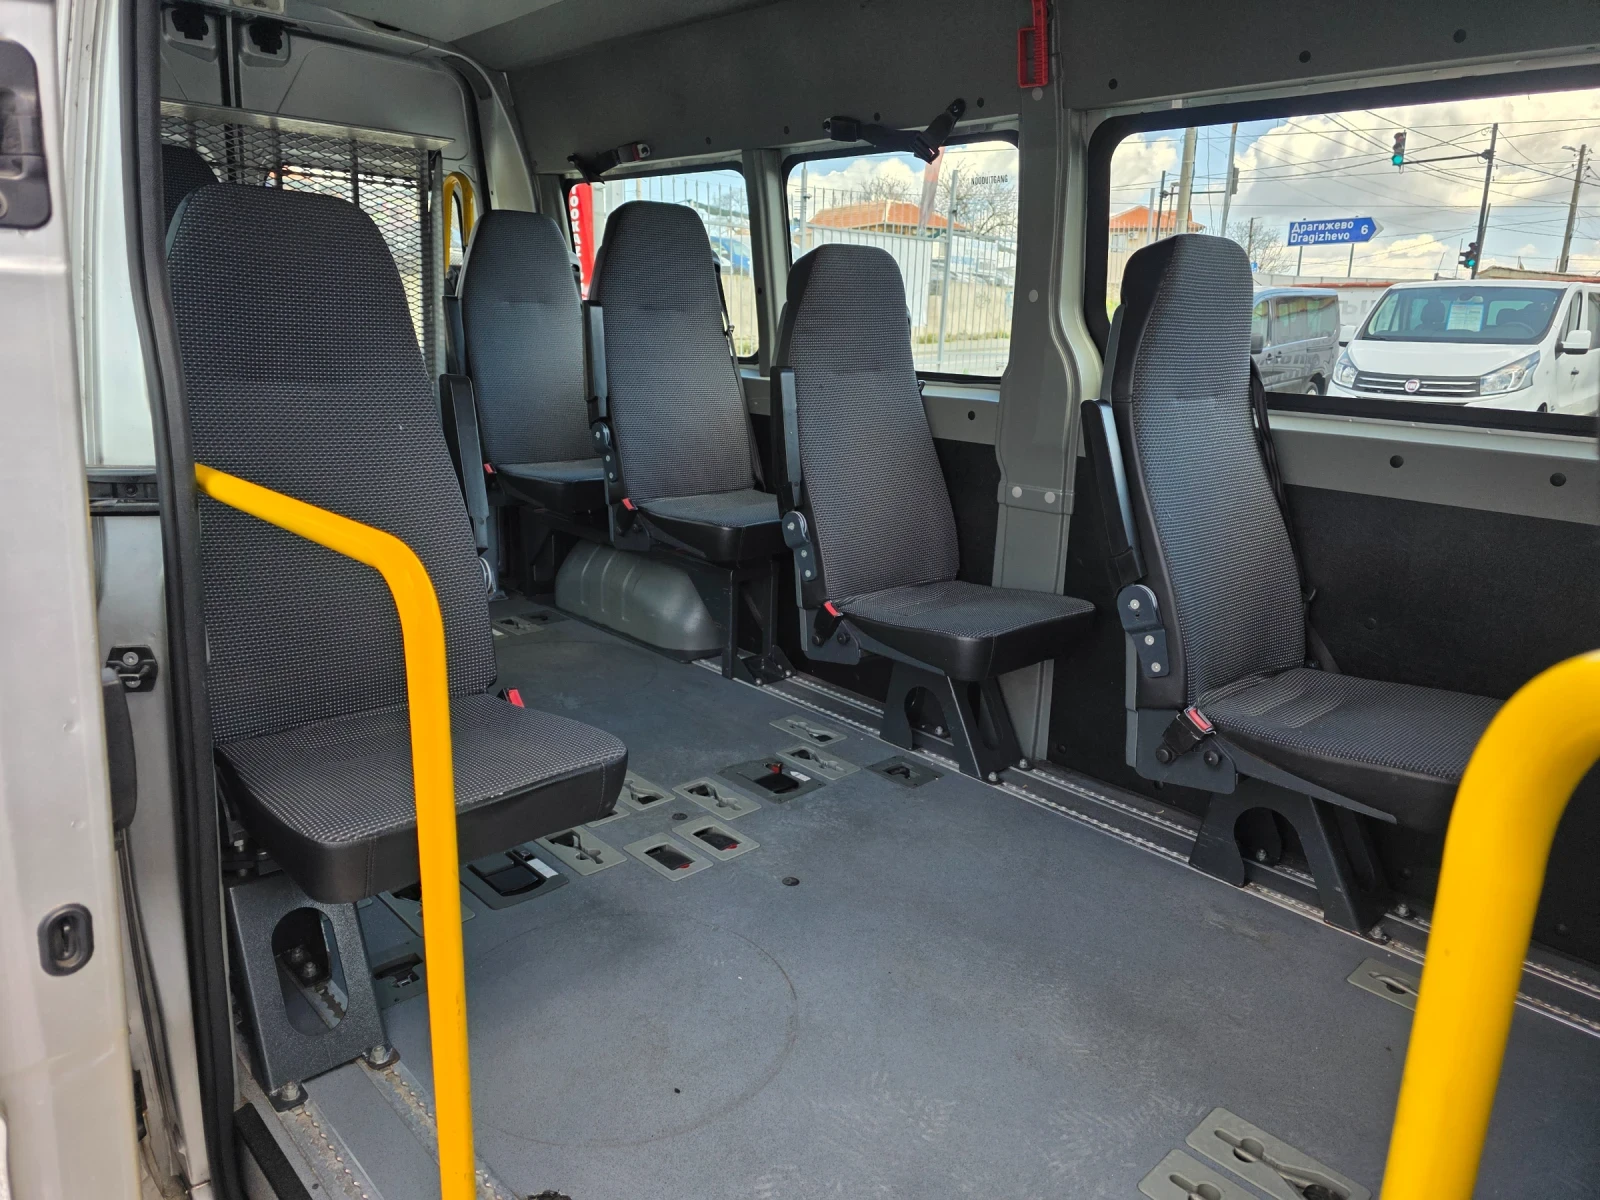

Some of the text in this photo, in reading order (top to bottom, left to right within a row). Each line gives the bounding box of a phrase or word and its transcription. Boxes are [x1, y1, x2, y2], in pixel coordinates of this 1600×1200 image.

[1292, 221, 1354, 233] Драгижево
[1360, 224, 1369, 235] 6
[1291, 232, 1350, 243] Dragizhevo
